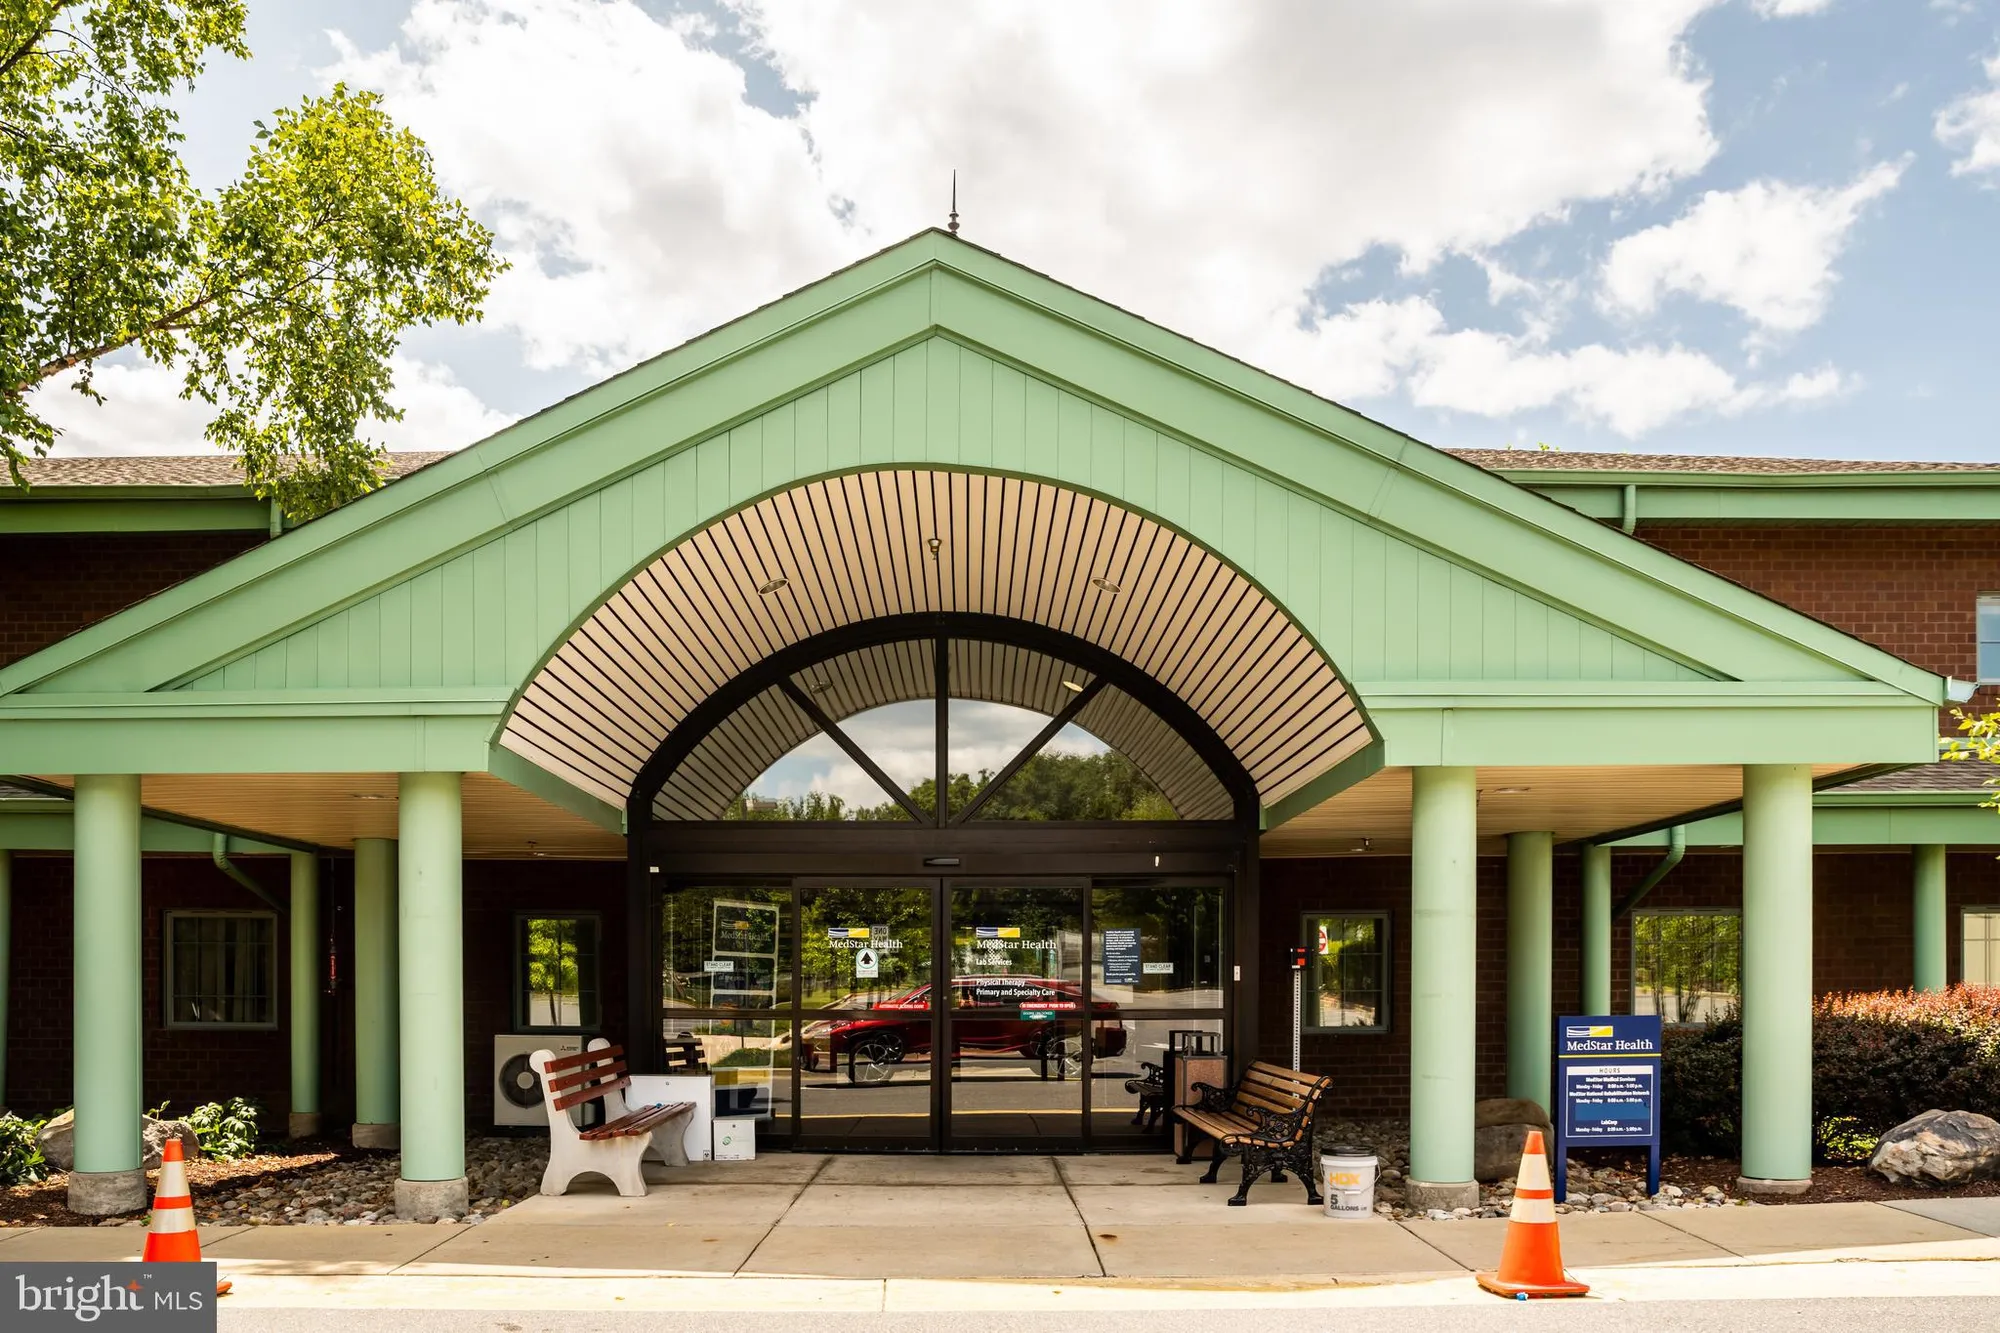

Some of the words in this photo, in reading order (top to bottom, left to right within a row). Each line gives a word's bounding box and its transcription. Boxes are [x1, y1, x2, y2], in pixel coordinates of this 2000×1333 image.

[828, 940, 869, 949] MedStar
[870, 939, 904, 949] Health
[976, 940, 1020, 949] MedStar
[1021, 940, 1057, 949] Health
[976, 979, 1001, 987] Physical
[1002, 979, 1026, 987] Therapy
[976, 988, 1000, 997] Primary
[1001, 988, 1012, 996] and
[1014, 988, 1041, 997] Specialty
[1566, 1040, 1613, 1051] MedStar
[1615, 1039, 1653, 1050] Health
[1329, 1172, 1361, 1185] HDX
[1330, 1193, 1339, 1205] 5
